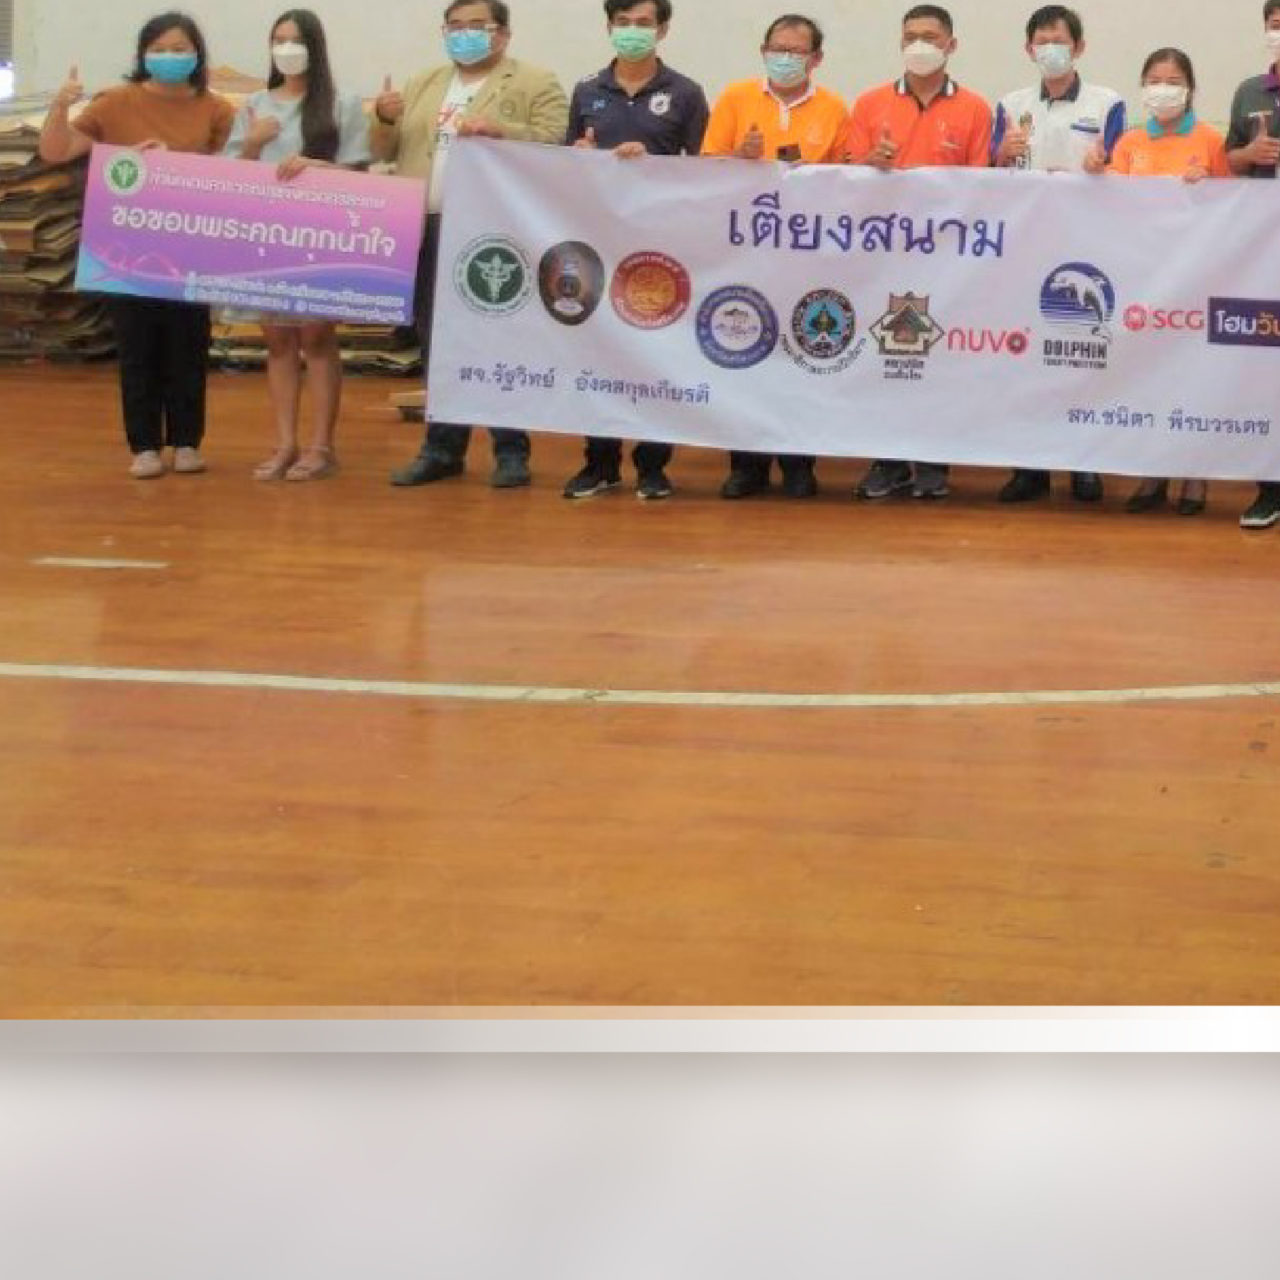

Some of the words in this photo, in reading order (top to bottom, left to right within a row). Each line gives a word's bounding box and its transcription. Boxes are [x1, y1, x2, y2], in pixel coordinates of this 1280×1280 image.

[112, 206, 397, 261] ขอขอบพระคุณทุกน้ำใจ
[728, 190, 1004, 258] เตียงสนาม
[1152, 309, 1205, 331] SCG
[1043, 339, 1107, 360] DOLPHIN
